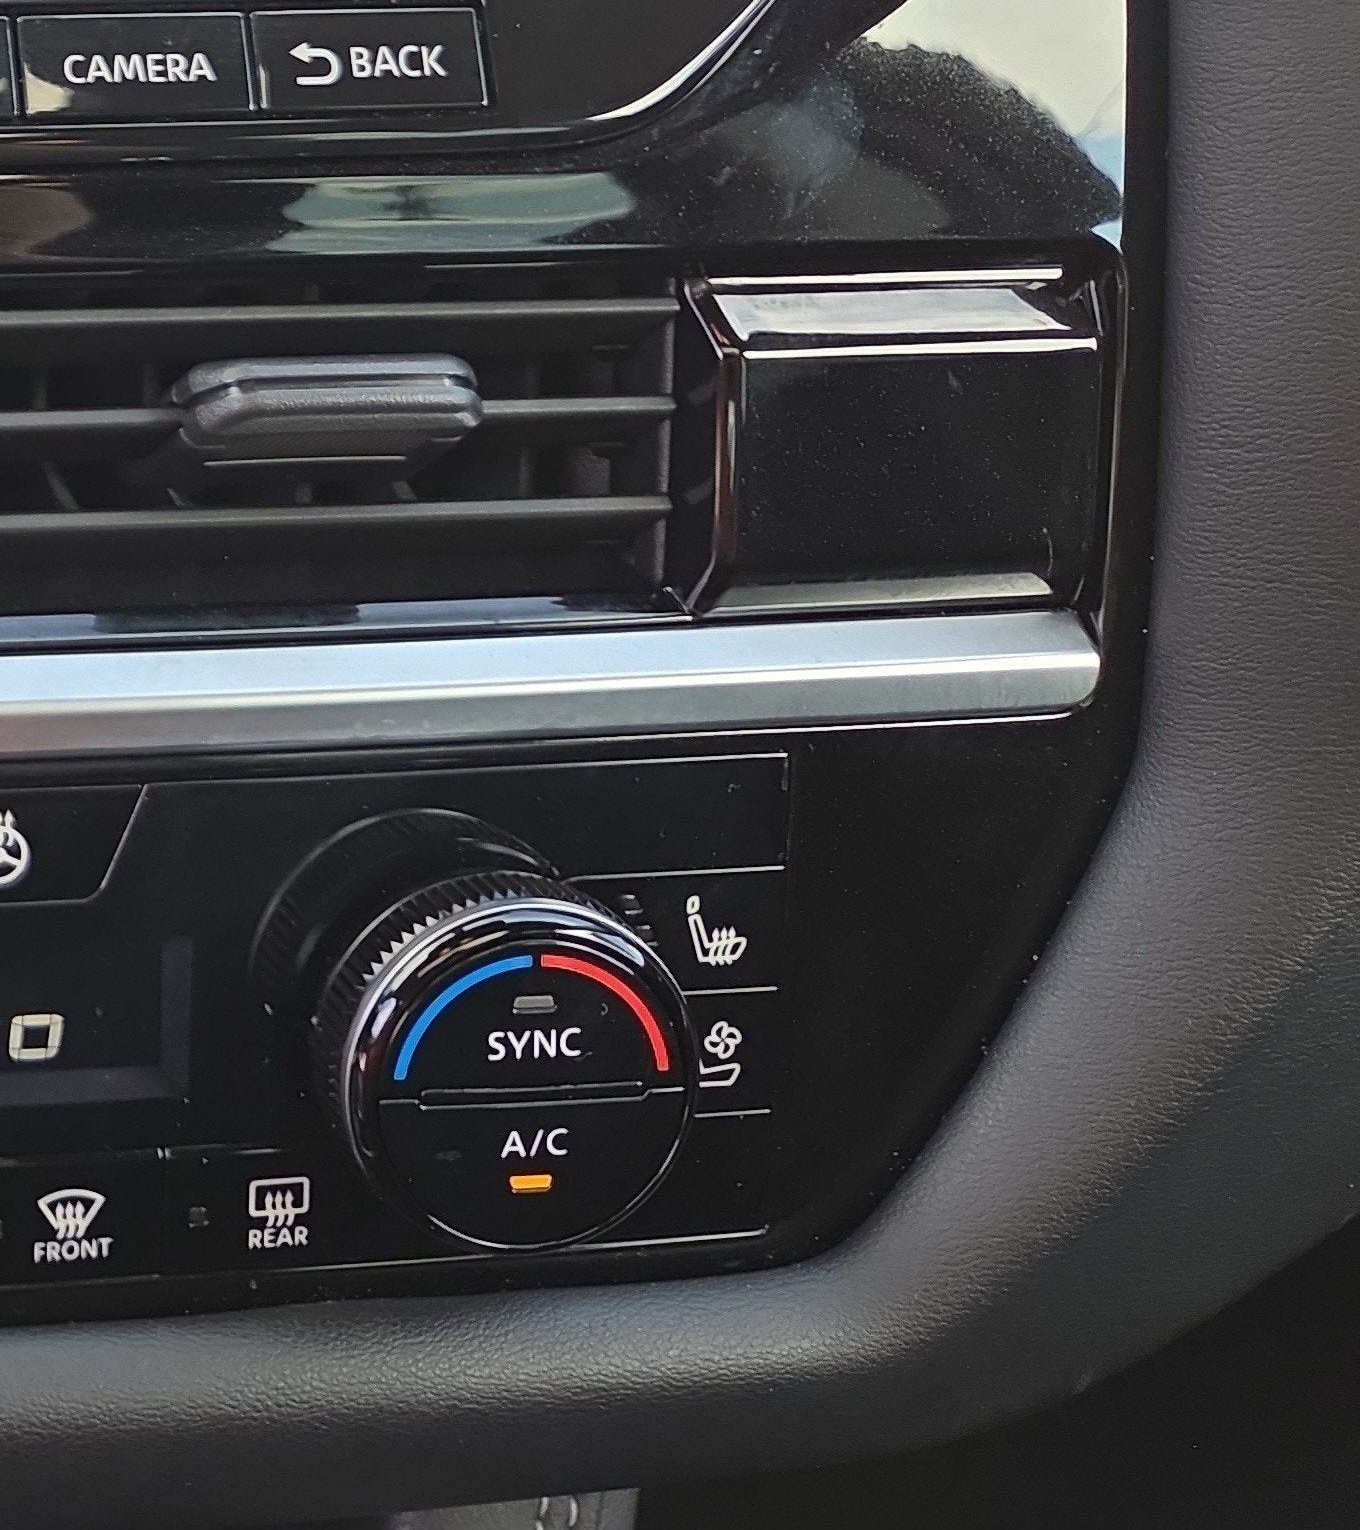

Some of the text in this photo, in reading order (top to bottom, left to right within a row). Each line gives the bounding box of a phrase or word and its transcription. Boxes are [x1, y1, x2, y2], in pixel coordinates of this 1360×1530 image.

[62, 51, 218, 84] CAMERA
[348, 43, 449, 79] BACK
[487, 1027, 582, 1061] SYNC
[500, 1127, 570, 1159] A/C
[33, 1236, 114, 1264] FRONT
[247, 1225, 309, 1250] REAR
